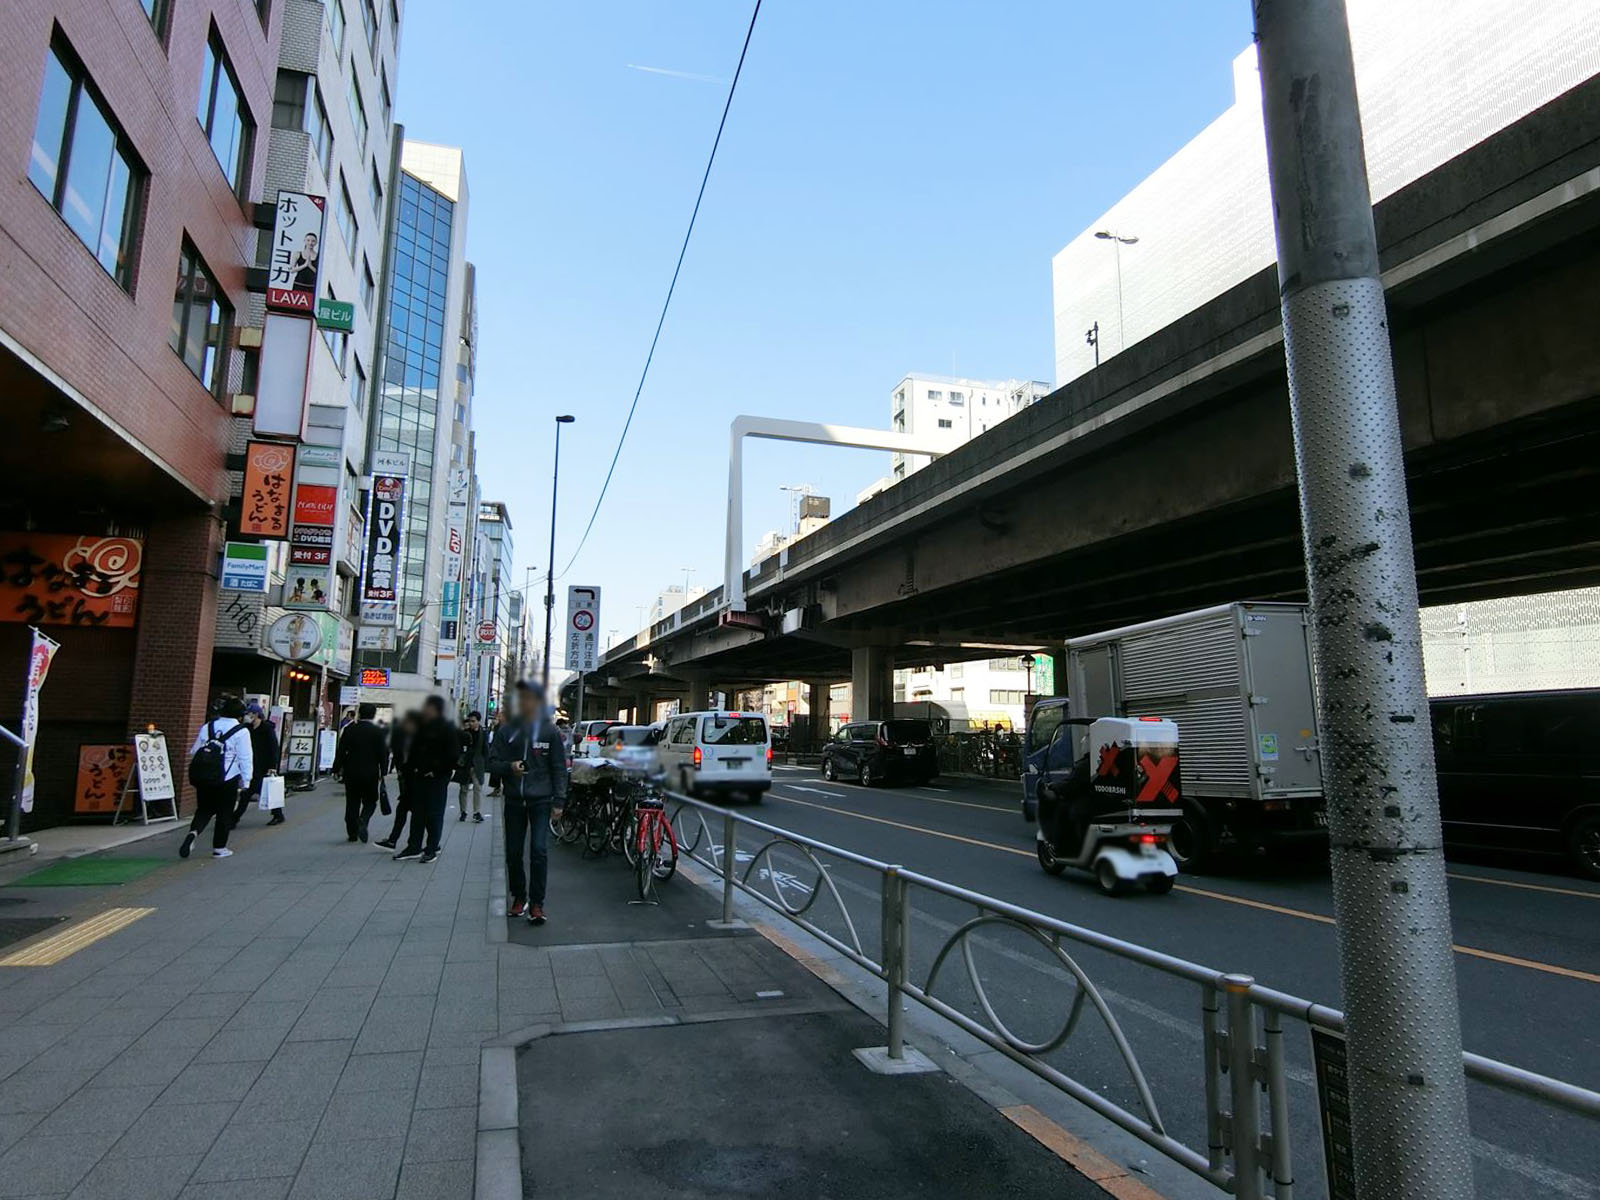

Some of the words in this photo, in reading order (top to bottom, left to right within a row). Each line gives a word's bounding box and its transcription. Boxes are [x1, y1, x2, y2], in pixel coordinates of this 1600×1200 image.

[272, 197, 298, 284] ホットヨガ
[272, 291, 309, 306] LAVA
[316, 306, 351, 321] 屋ビル
[248, 489, 269, 523] うどん
[264, 473, 286, 531] はなまる
[315, 552, 328, 560] 3F
[227, 562, 264, 571] FamilyMart
[16, 595, 109, 621] うどん
[1094, 784, 1127, 795] YODOBASHI
